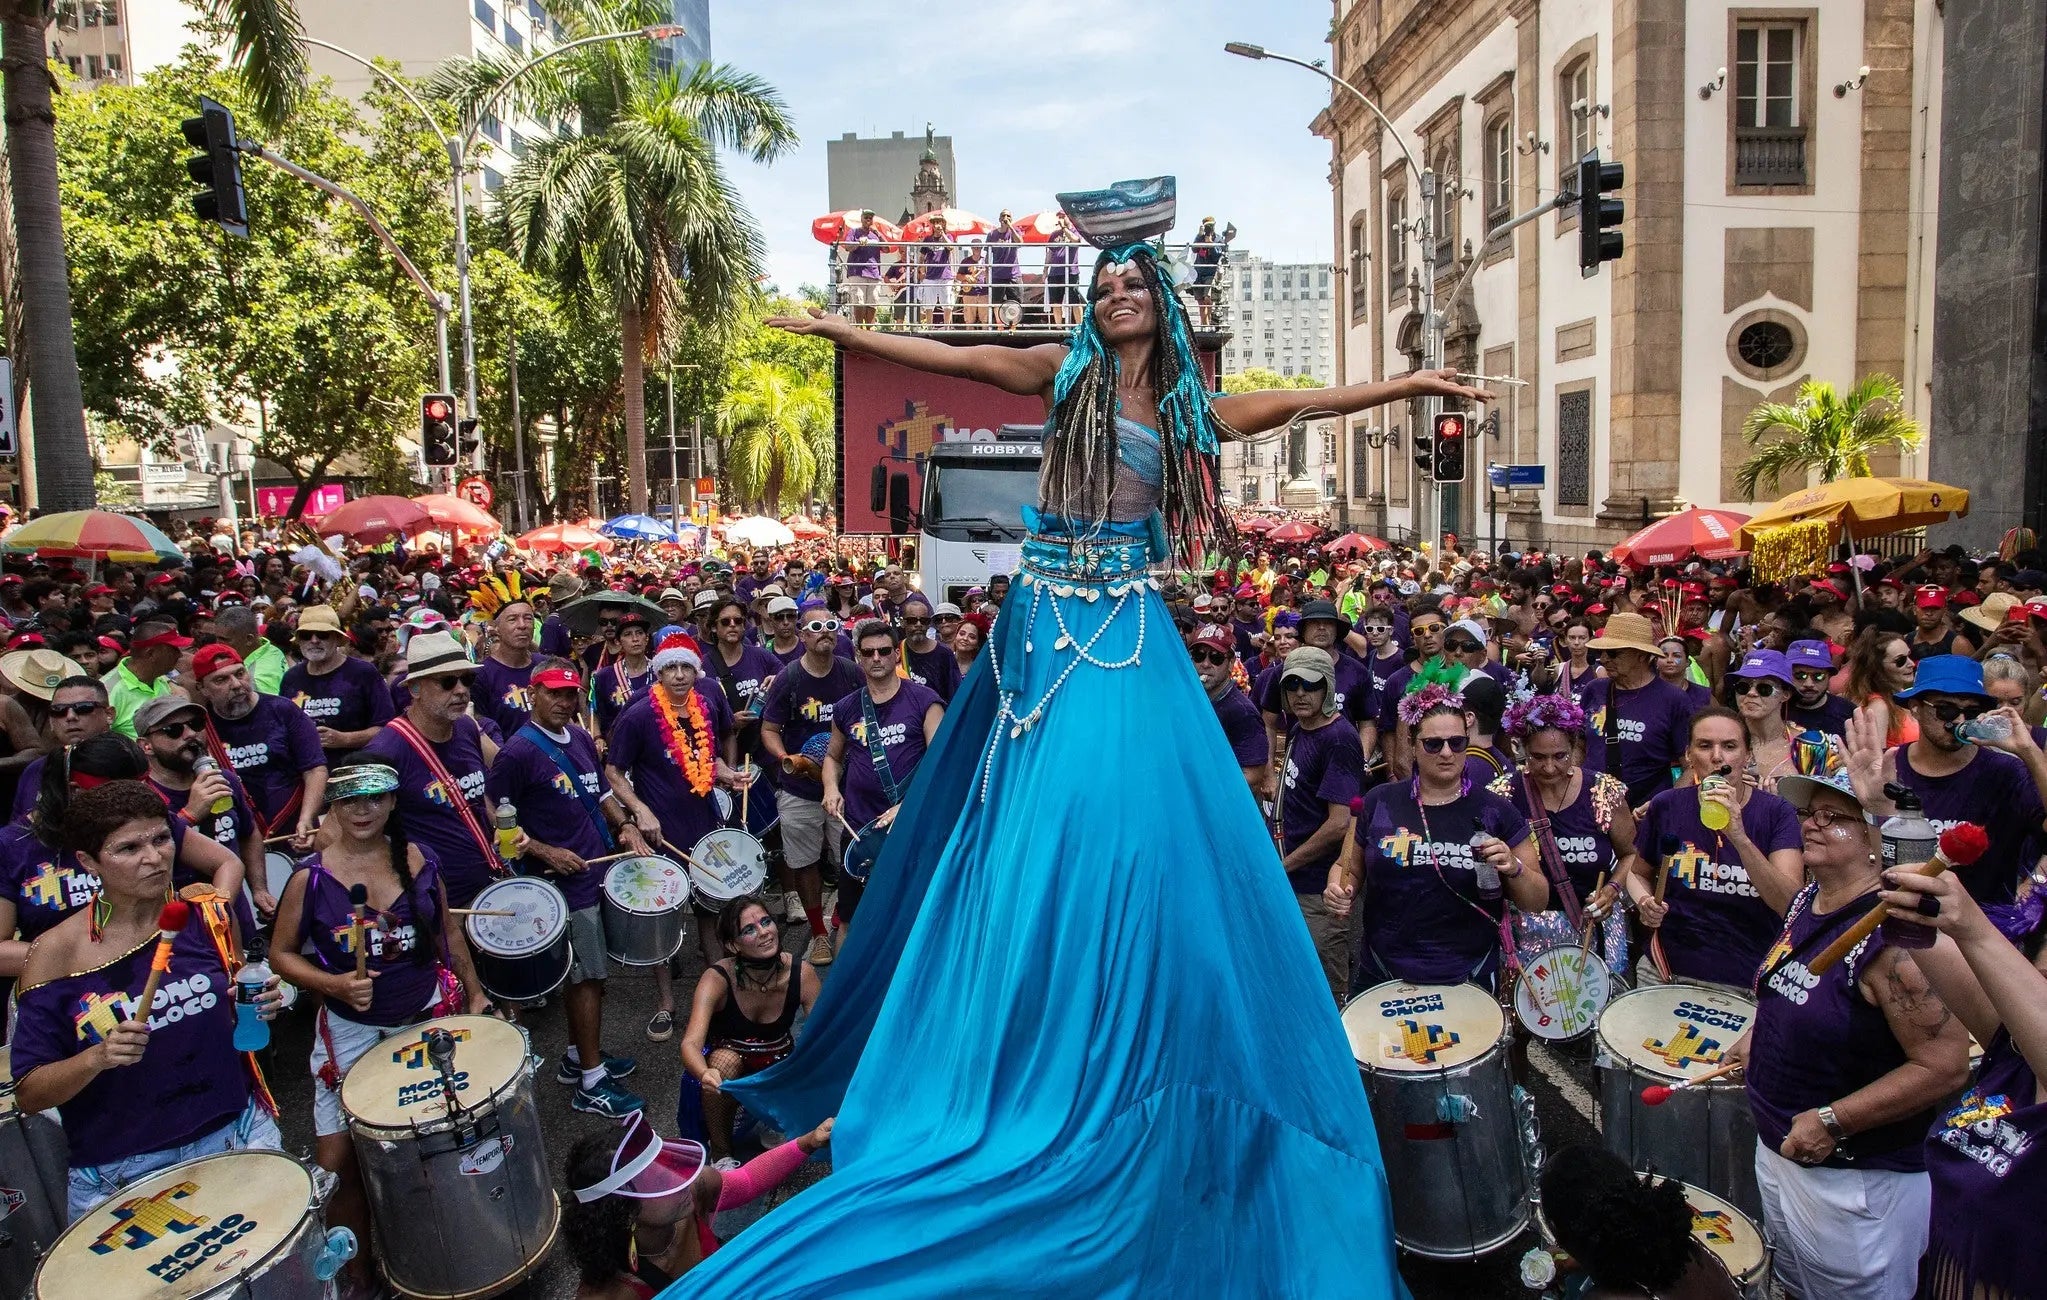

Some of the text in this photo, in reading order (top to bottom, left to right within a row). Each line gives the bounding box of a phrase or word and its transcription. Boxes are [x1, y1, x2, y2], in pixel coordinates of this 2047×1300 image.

[972, 445, 1042, 455] HOBBY &
[1649, 553, 1674, 563] BRAHMA
[736, 679, 758, 691] ONO
[820, 704, 833, 714] MO
[879, 723, 906, 738] ONO
[1617, 719, 1646, 733] ONO
[1555, 836, 1596, 851] ONO
[1413, 855, 1474, 870] BLOCO
[1700, 860, 1748, 882] MON
[723, 864, 748, 884] MONO
[728, 870, 752, 889] BLOCO
[1768, 973, 1809, 1005] BLOCO
[1380, 993, 1442, 1008] BLOCO
[1381, 1001, 1445, 1017] MONO
[147, 993, 217, 1031] LOCO
[1673, 1008, 1743, 1032] MONO
[1679, 1001, 1748, 1023] BLOCO
[1942, 1129, 2011, 1177] BLOCO
[146, 1213, 244, 1276] MONO
[161, 1221, 257, 1284] BLOCO
